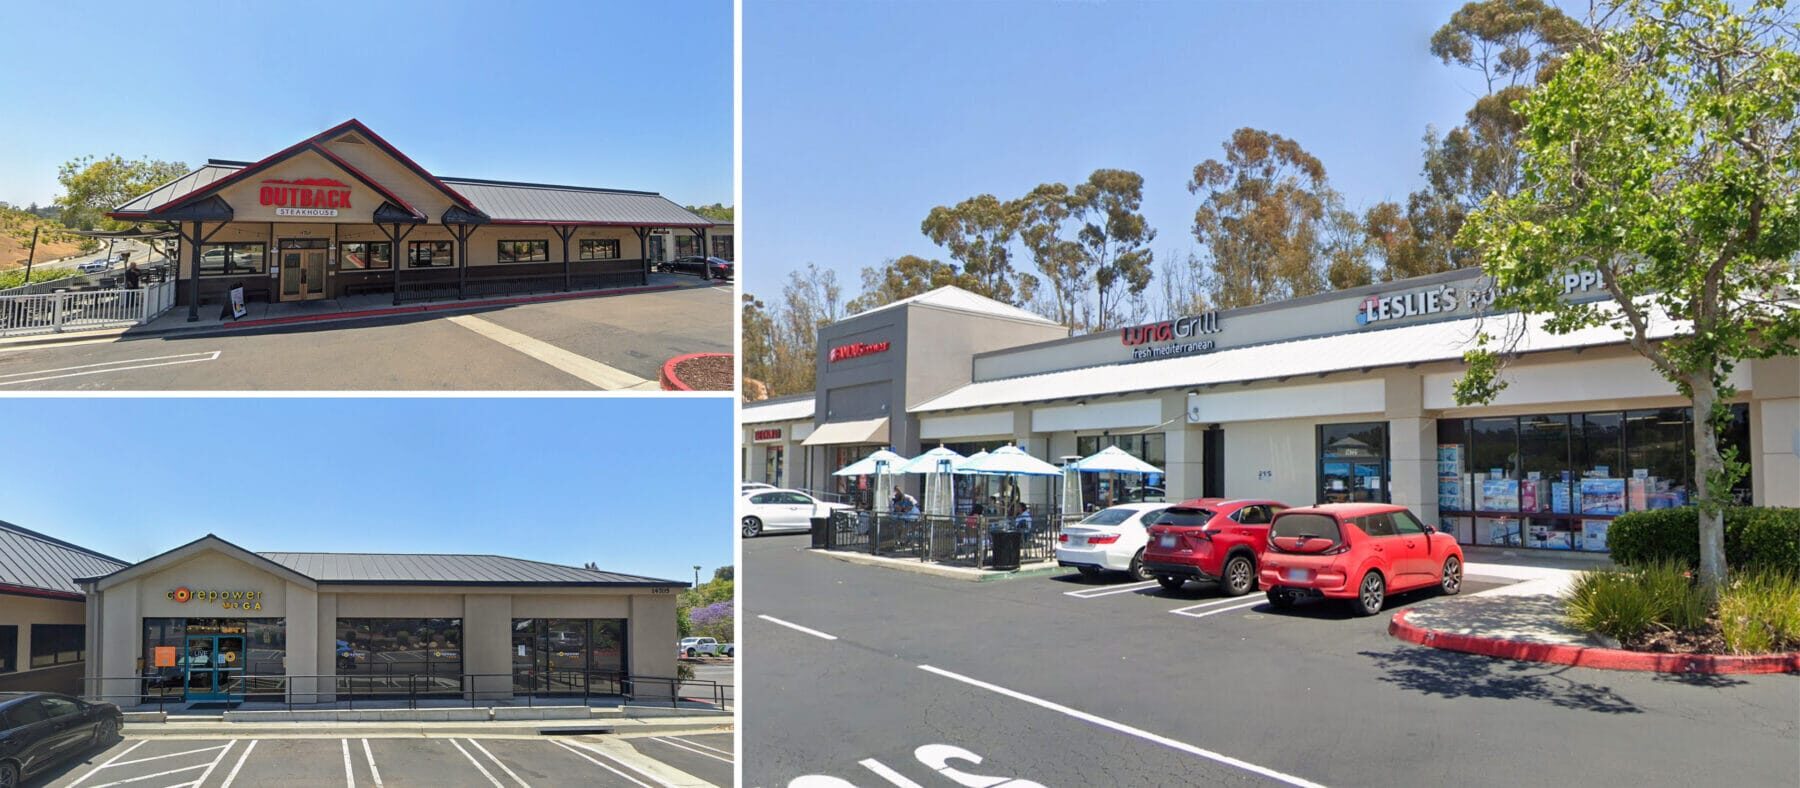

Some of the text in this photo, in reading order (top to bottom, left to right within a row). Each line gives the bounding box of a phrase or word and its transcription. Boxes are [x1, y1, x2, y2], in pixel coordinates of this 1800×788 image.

[260, 186, 352, 208] OUTBACK
[279, 208, 335, 216] STEAKHOUSE
[1366, 284, 1457, 322] LESLIE'S
[1131, 340, 1214, 359] fresh mediterranean
[166, 586, 263, 608] corepower
